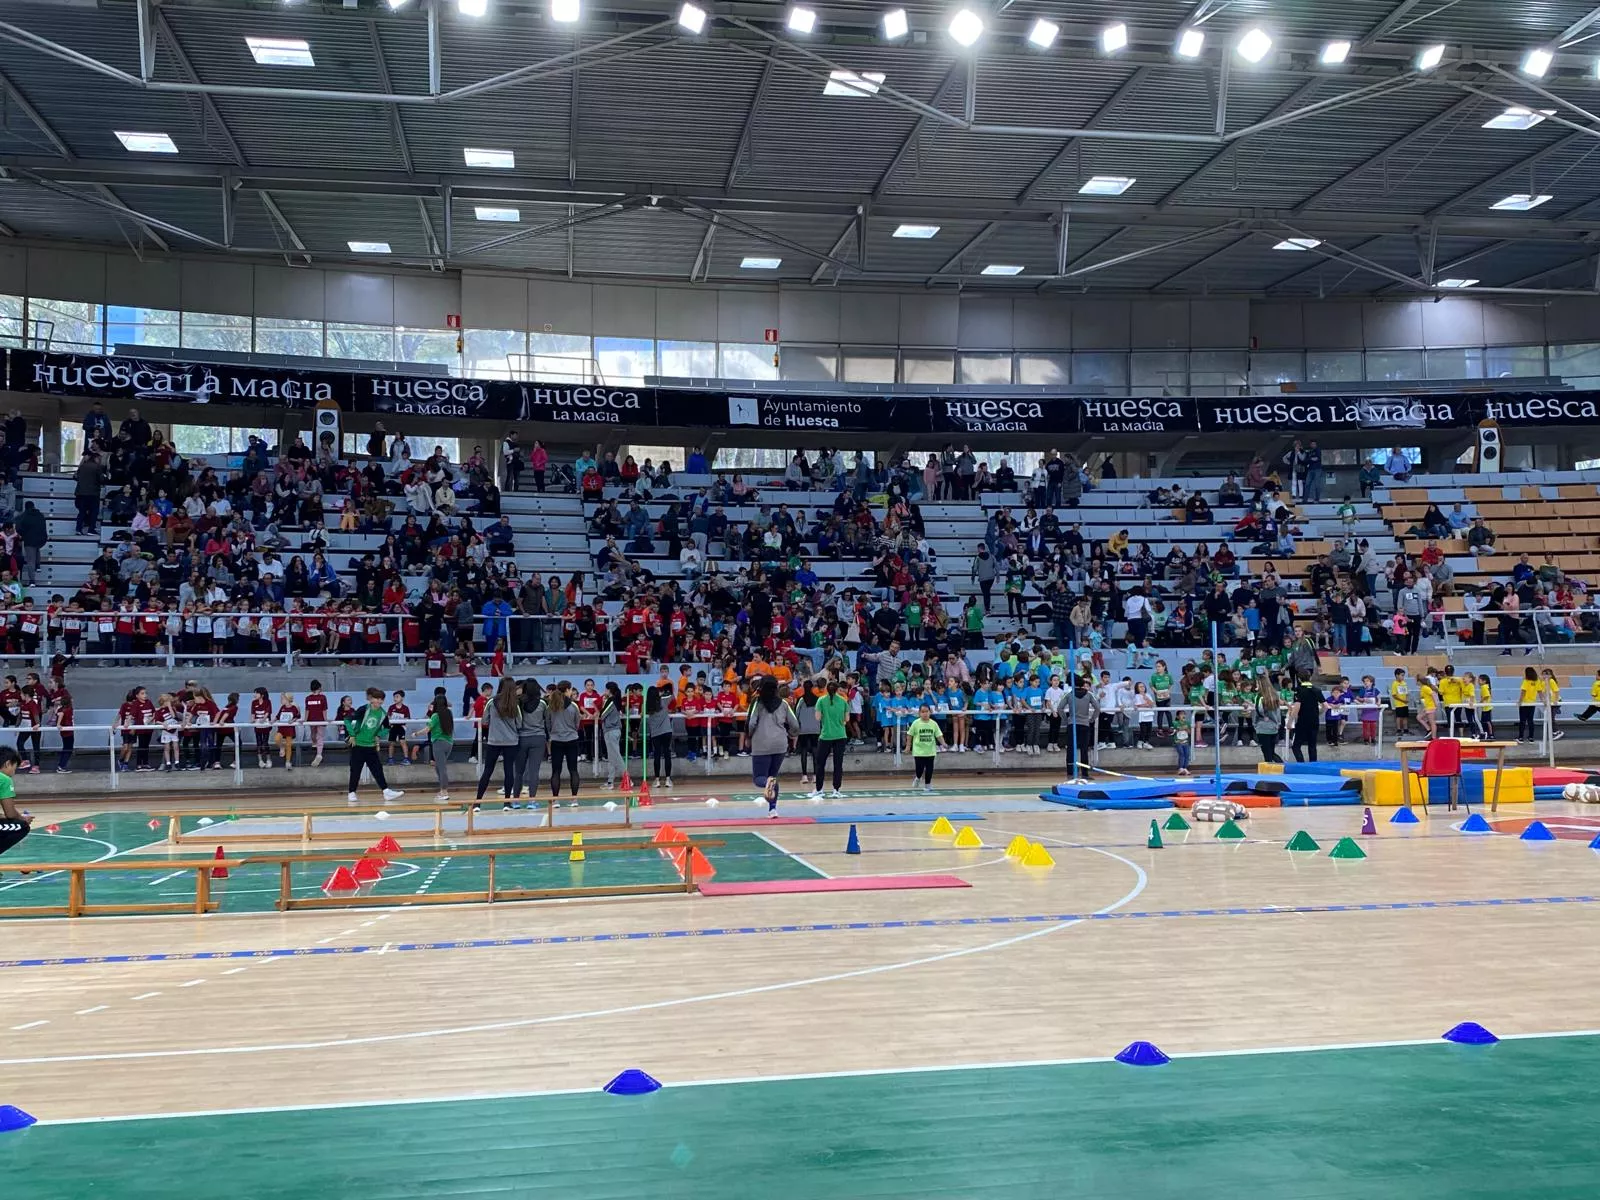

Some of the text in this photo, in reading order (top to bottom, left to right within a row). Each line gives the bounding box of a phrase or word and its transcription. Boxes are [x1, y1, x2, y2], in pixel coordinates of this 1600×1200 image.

[764, 399, 861, 414] Ayuntamiento
[764, 415, 839, 428] de Huesca
